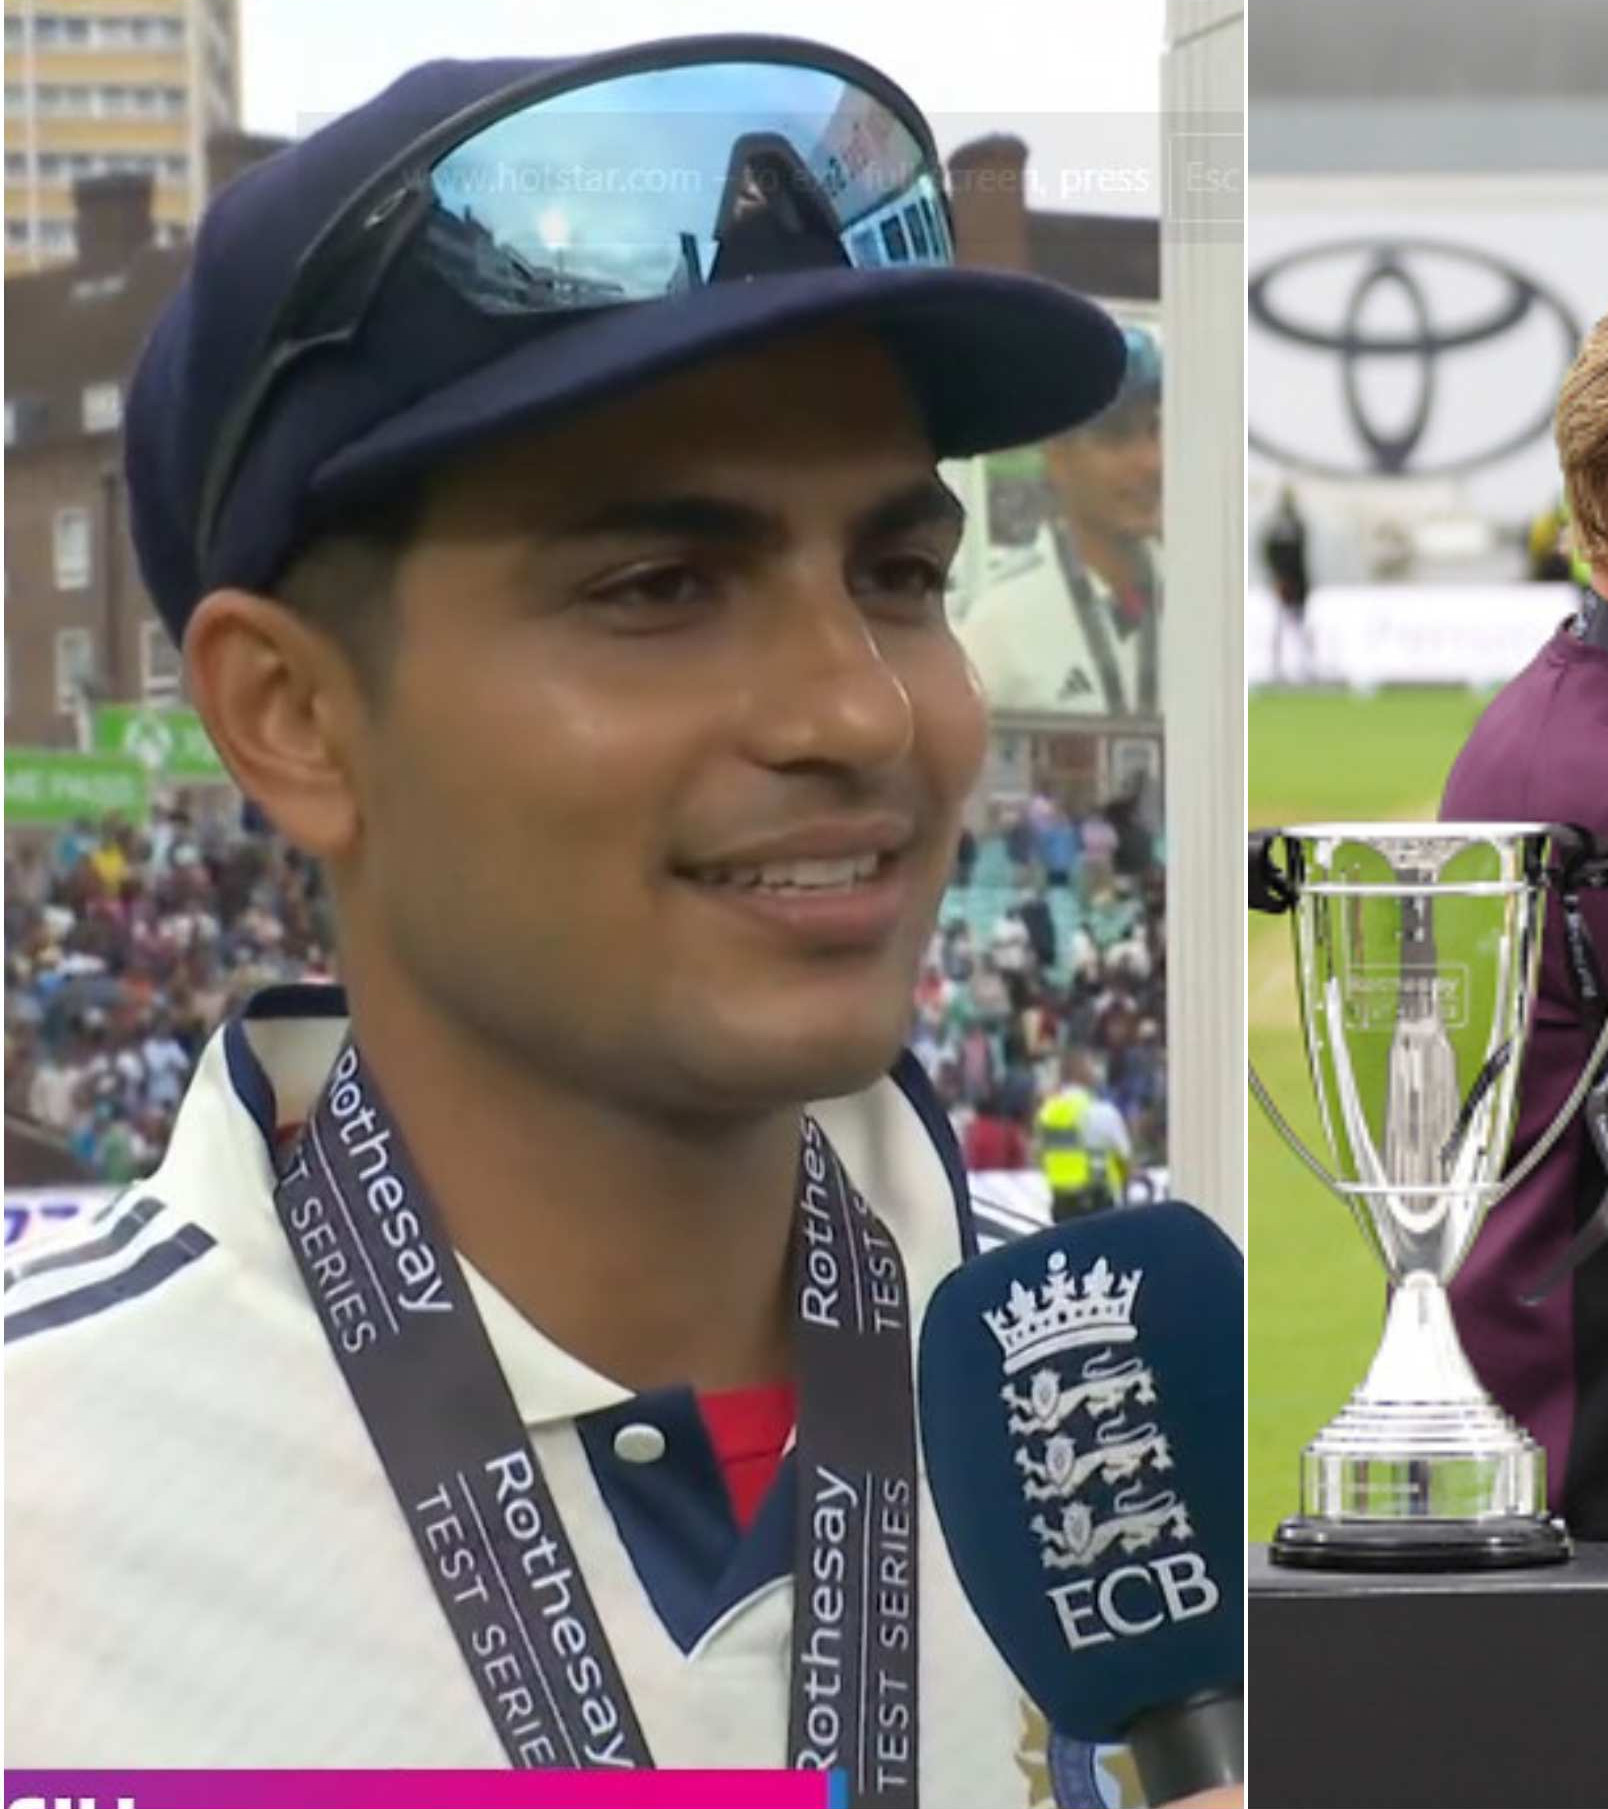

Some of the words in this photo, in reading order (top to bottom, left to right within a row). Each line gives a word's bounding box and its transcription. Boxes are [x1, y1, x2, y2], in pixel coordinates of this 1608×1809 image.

[329, 1045, 453, 1313] Rothesay
[800, 1117, 841, 1328] Rothes
[290, 1196, 376, 1353] SERIES
[863, 1229, 902, 1334] TEST
[416, 1483, 489, 1604] TEST
[472, 1623, 556, 1769] SERIE
[485, 1449, 635, 1768] Rothesay
[880, 1477, 910, 1651] SERIES
[1046, 1552, 1220, 1650] ECB
[877, 1671, 909, 1793] TEST
